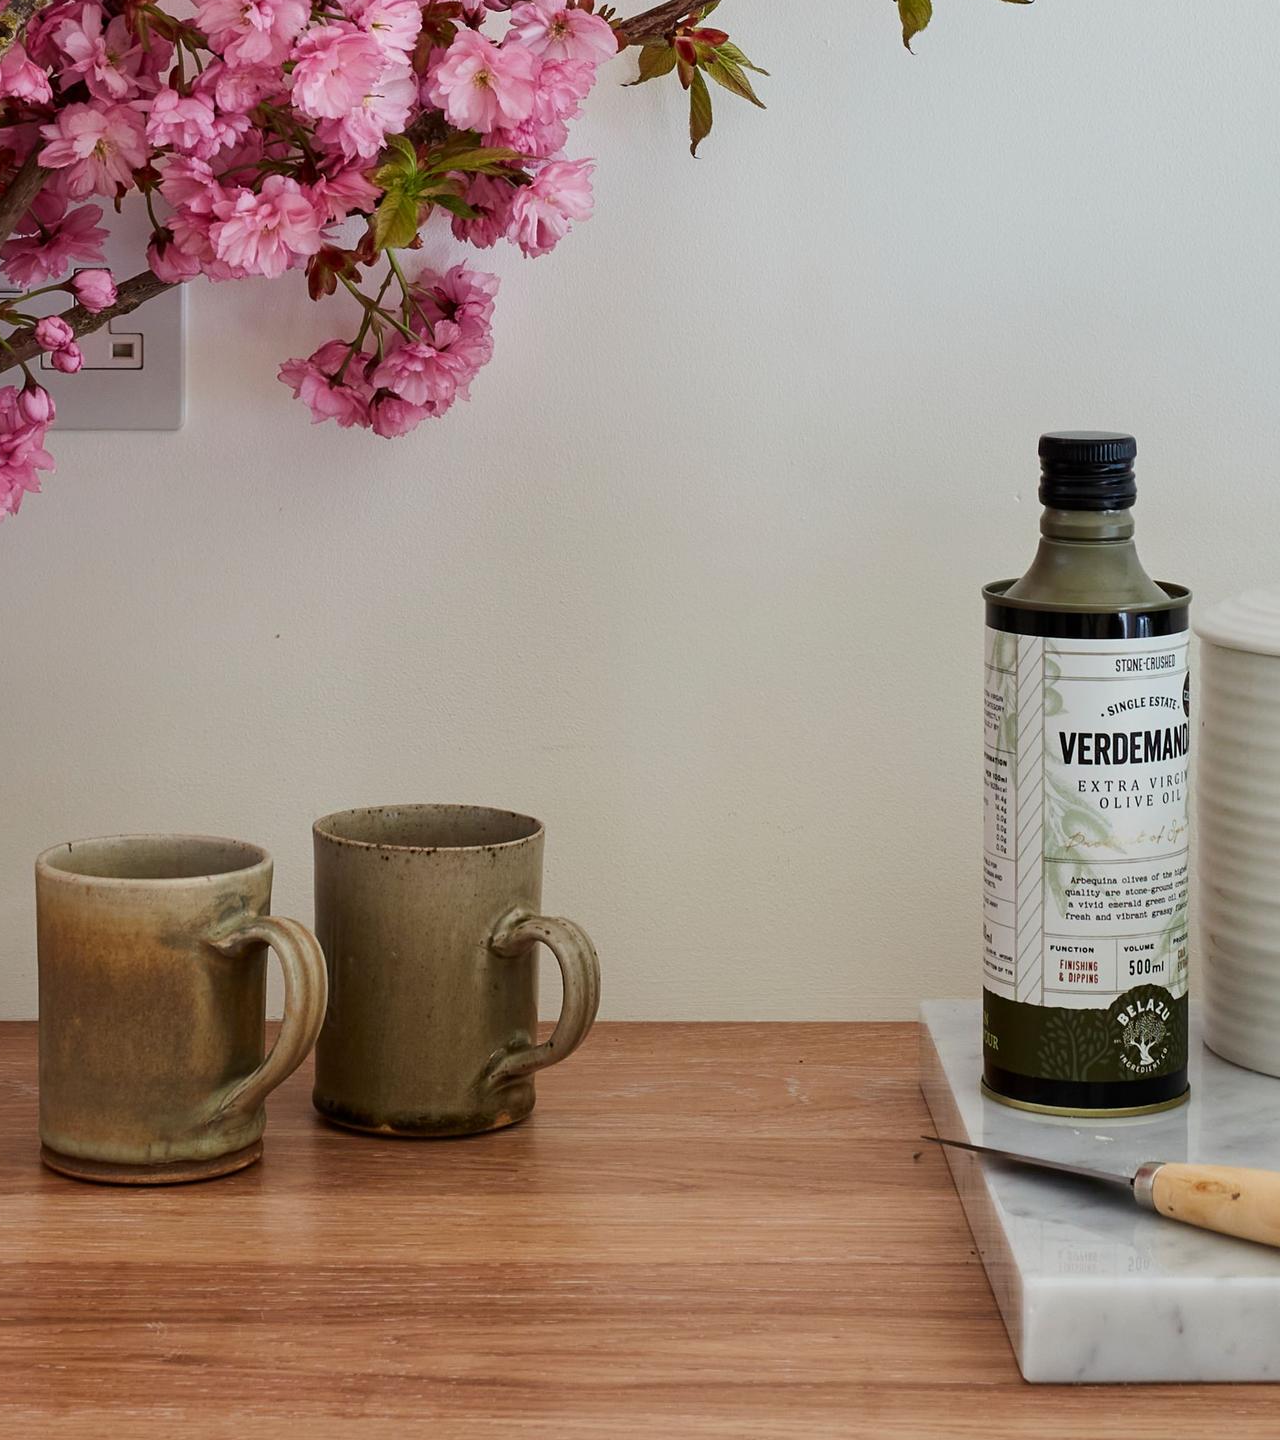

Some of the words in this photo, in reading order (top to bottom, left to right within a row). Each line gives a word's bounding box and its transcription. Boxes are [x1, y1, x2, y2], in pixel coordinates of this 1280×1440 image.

[1115, 654, 1176, 673] STONE-CRUSHED
[1107, 697, 1147, 717] SINGLE
[1149, 696, 1177, 710] ESTATE
[1078, 779, 1140, 793] EXTRA
[1100, 793, 1154, 810] OLIVE
[1162, 789, 1181, 805] OIL
[1070, 876, 1118, 886] Arbequina
[1121, 875, 1148, 885] olives
[1151, 872, 1160, 882] of
[1162, 871, 1173, 880] the
[1065, 888, 1101, 899] quality
[1125, 883, 1173, 897] stone-ground
[1078, 901, 1103, 909] vivid
[1108, 900, 1141, 909] emerald
[1145, 897, 1166, 908] green
[1065, 912, 1091, 921] fresh
[1095, 912, 1111, 920] and
[1116, 911, 1148, 920] vibrant
[1151, 907, 1173, 920] grassy
[1050, 945, 1095, 953] FUNCTION
[1124, 943, 1155, 952] VOLUME
[1060, 959, 1098, 972] FINISHING
[1129, 958, 1164, 976] 500ml
[1058, 972, 1064, 983] &
[1068, 972, 1099, 984] DIPPING
[1117, 999, 1170, 1027] BELAZU
[1120, 1053, 1161, 1074] INGREDIENT
